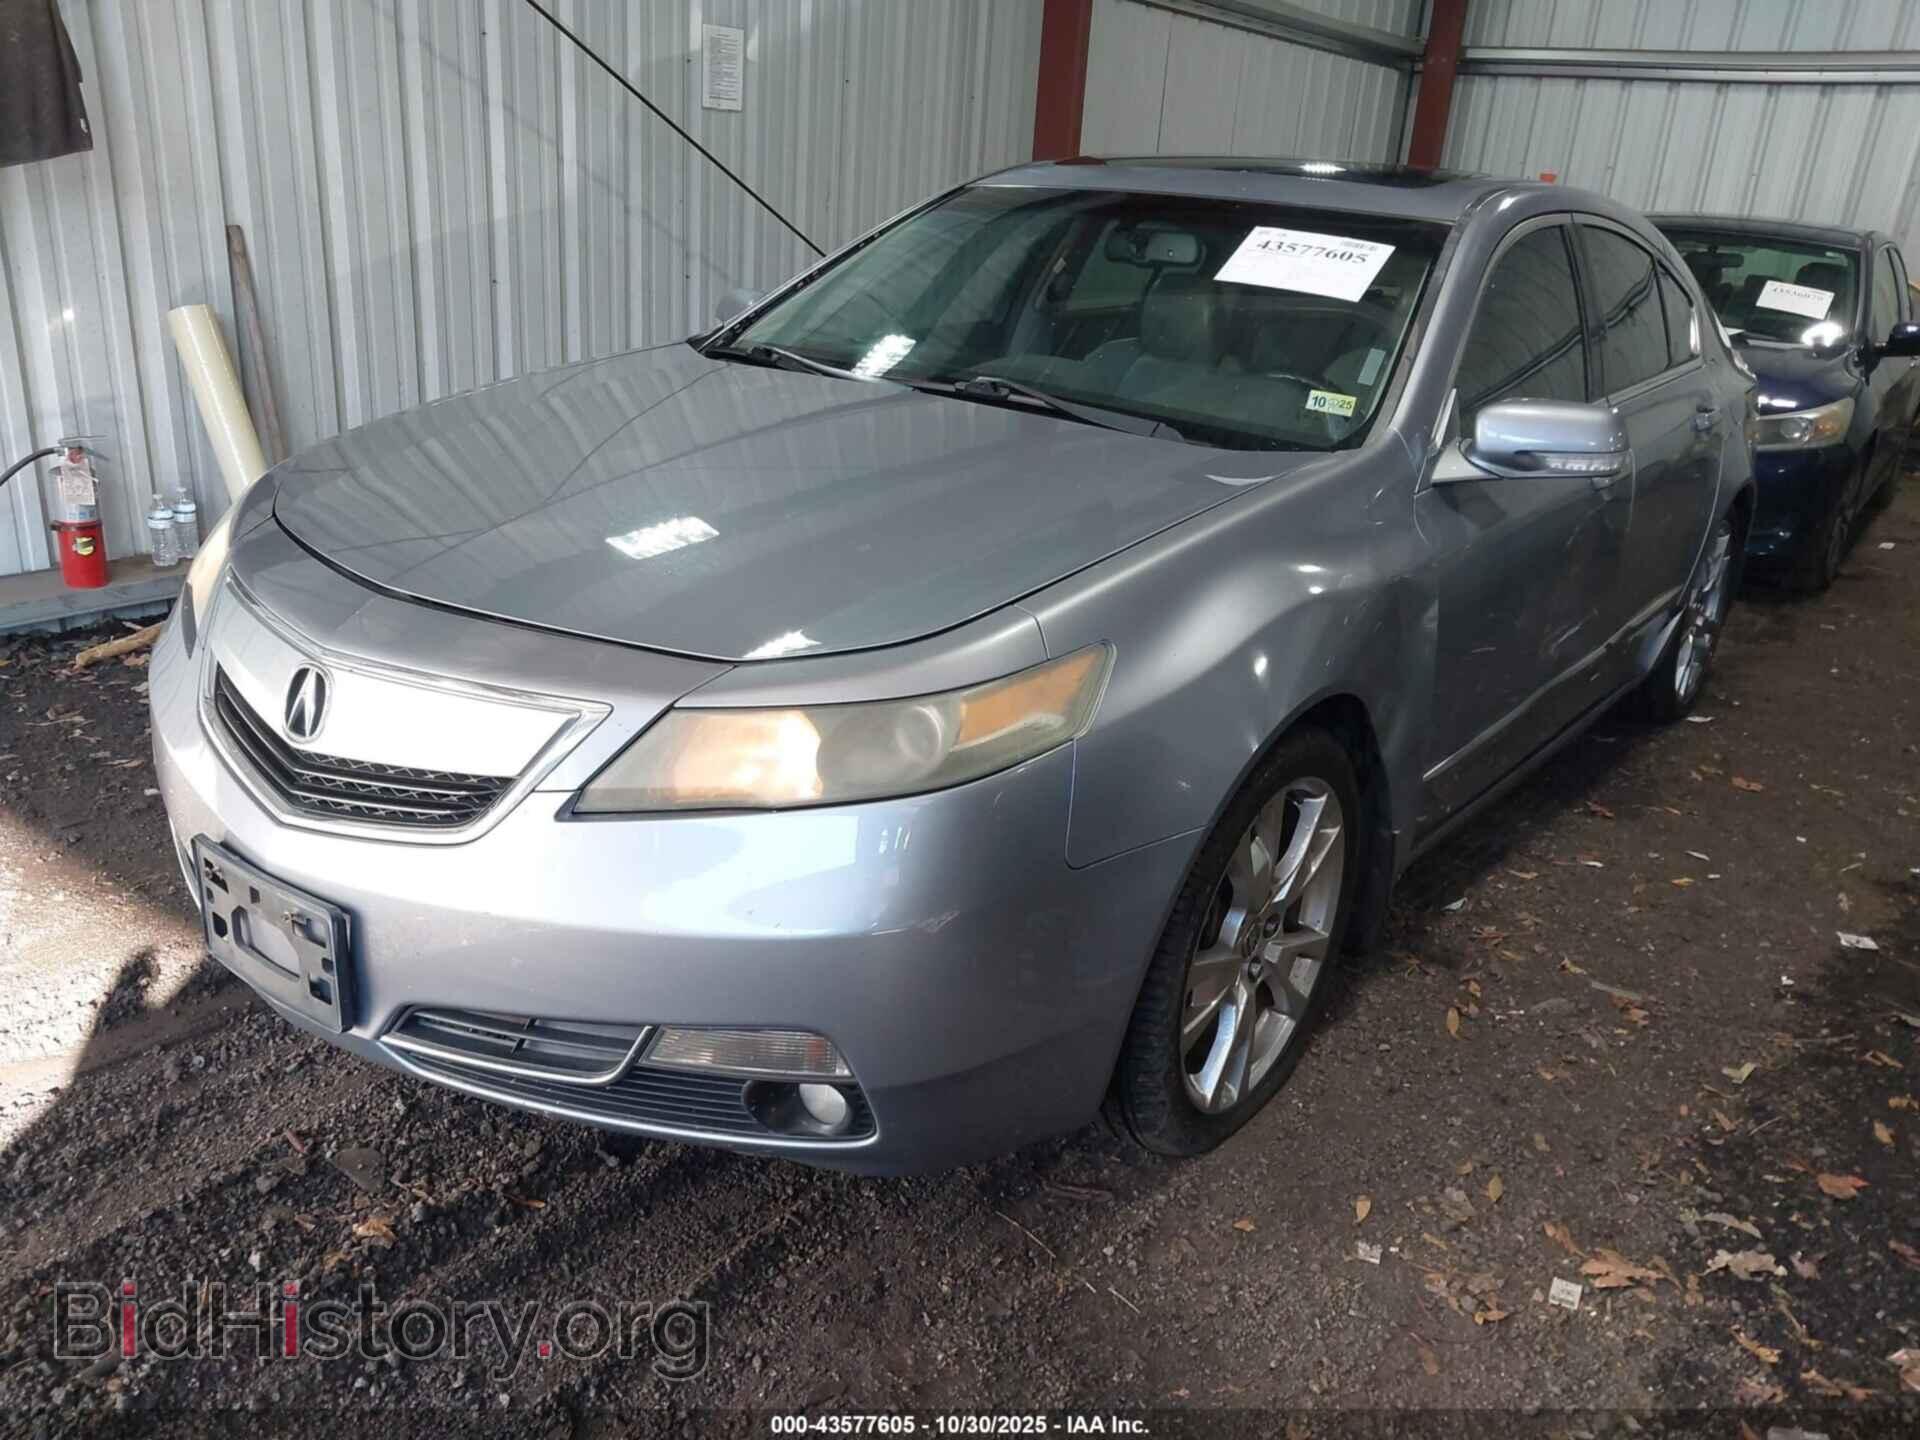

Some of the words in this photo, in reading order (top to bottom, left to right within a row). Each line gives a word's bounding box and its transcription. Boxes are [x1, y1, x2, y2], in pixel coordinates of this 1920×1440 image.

[1256, 239, 1370, 264] 43577605
[1312, 395, 1327, 408] 10
[1339, 399, 1353, 410] 25
